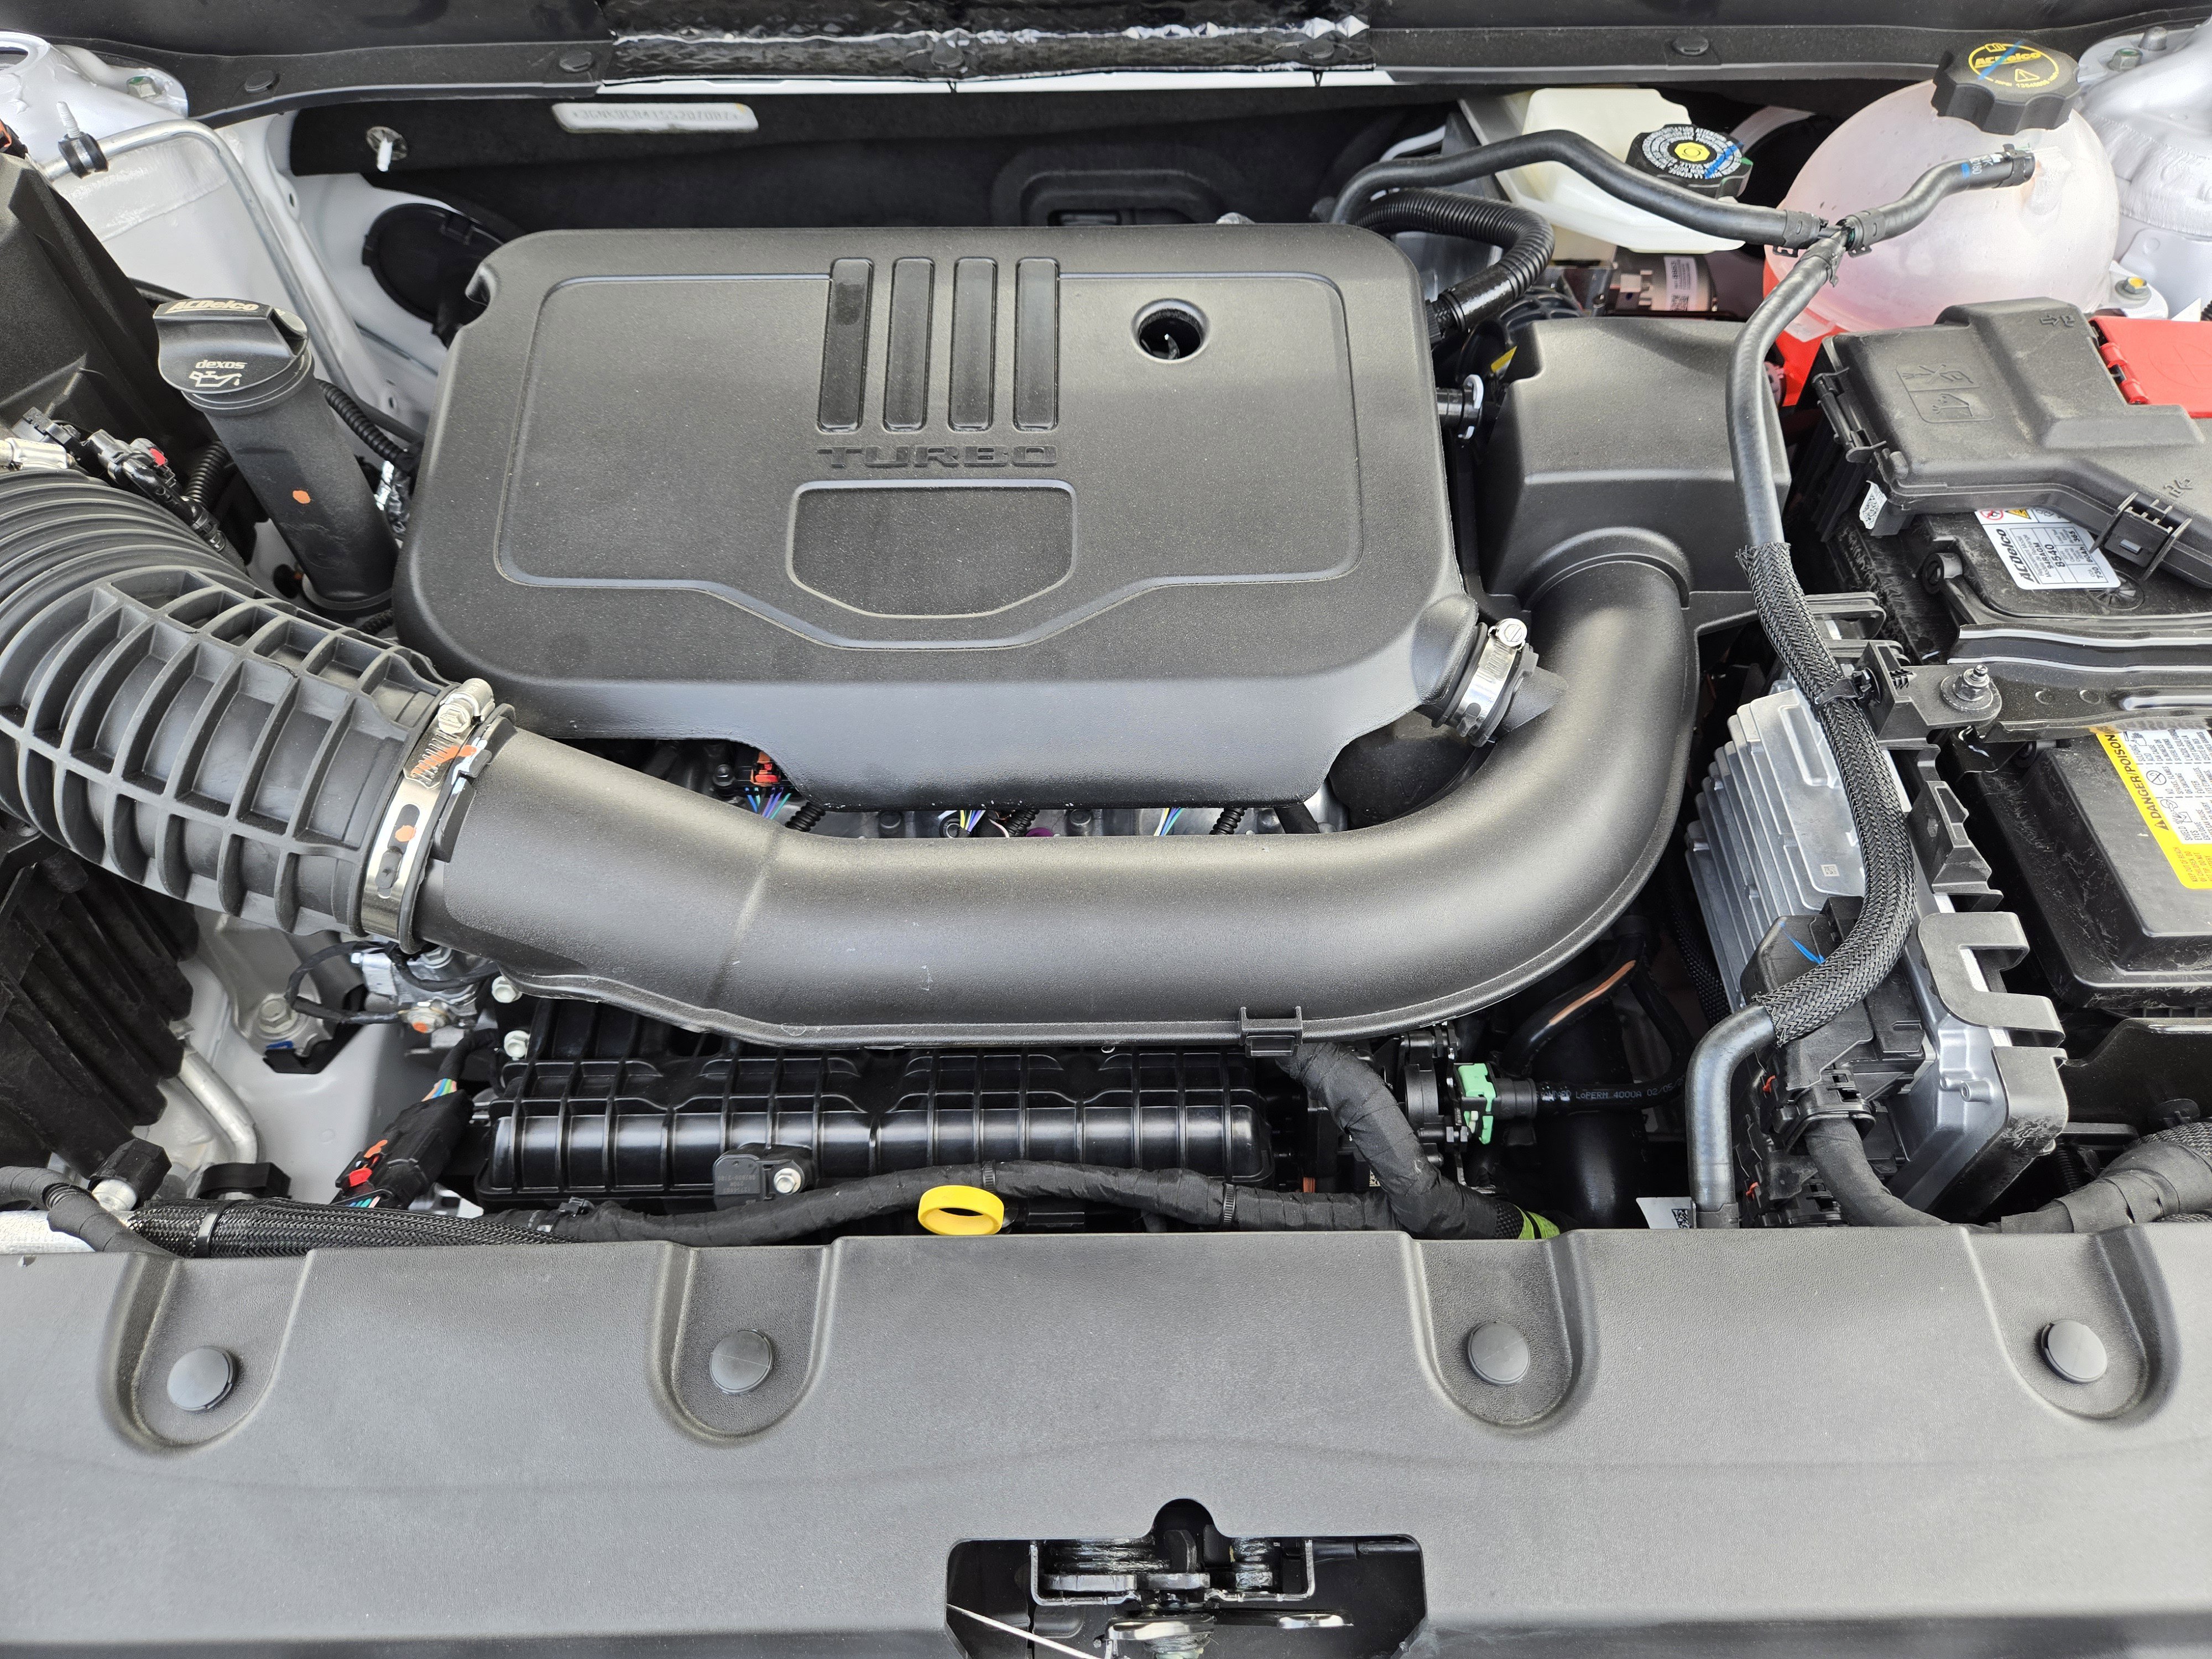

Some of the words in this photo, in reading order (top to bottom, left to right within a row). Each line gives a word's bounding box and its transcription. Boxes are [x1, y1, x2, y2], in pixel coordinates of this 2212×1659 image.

[168, 300, 259, 311] ACDelco
[195, 359, 247, 369] dexos
[817, 445, 1058, 468] TURBO
[2068, 531, 2080, 541] 365
[1996, 529, 2035, 582] ACDelco
[2032, 542, 2054, 568] 94RAGM
[2043, 544, 2065, 566] 8540
[2091, 567, 2104, 578] 730
[2105, 734, 2163, 818] DANGER/POISON
[2177, 826, 2193, 840] SHIELD
[2189, 830, 2202, 839] EYES
[2193, 822, 2211, 839] EXPLOSIVE
[2187, 873, 2198, 881] KEEP
[1576, 1091, 1608, 1100] LoPERM
